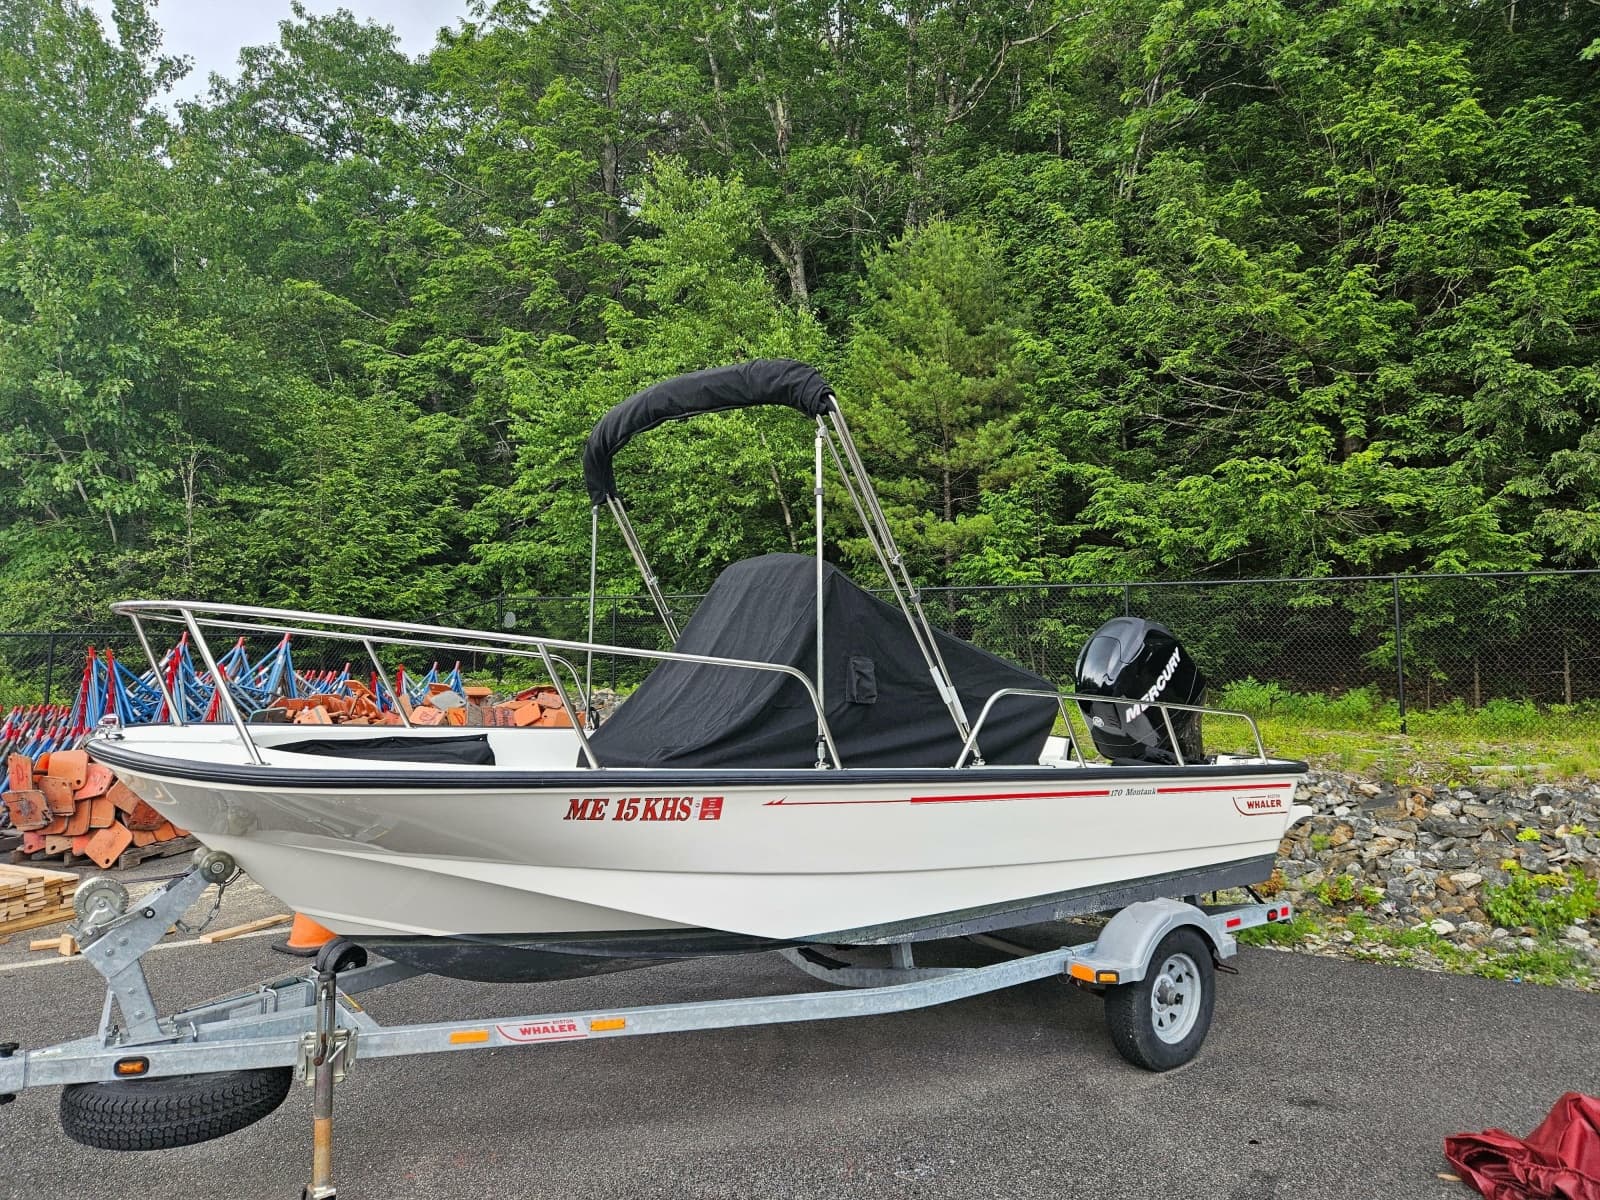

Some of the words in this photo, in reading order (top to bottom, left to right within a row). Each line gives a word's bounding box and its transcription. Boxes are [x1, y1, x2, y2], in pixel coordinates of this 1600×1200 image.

[1126, 646, 1180, 723] MERCURY
[563, 798, 609, 821] ME
[1247, 799, 1282, 809] WHALER
[520, 1024, 577, 1036] WHALER
